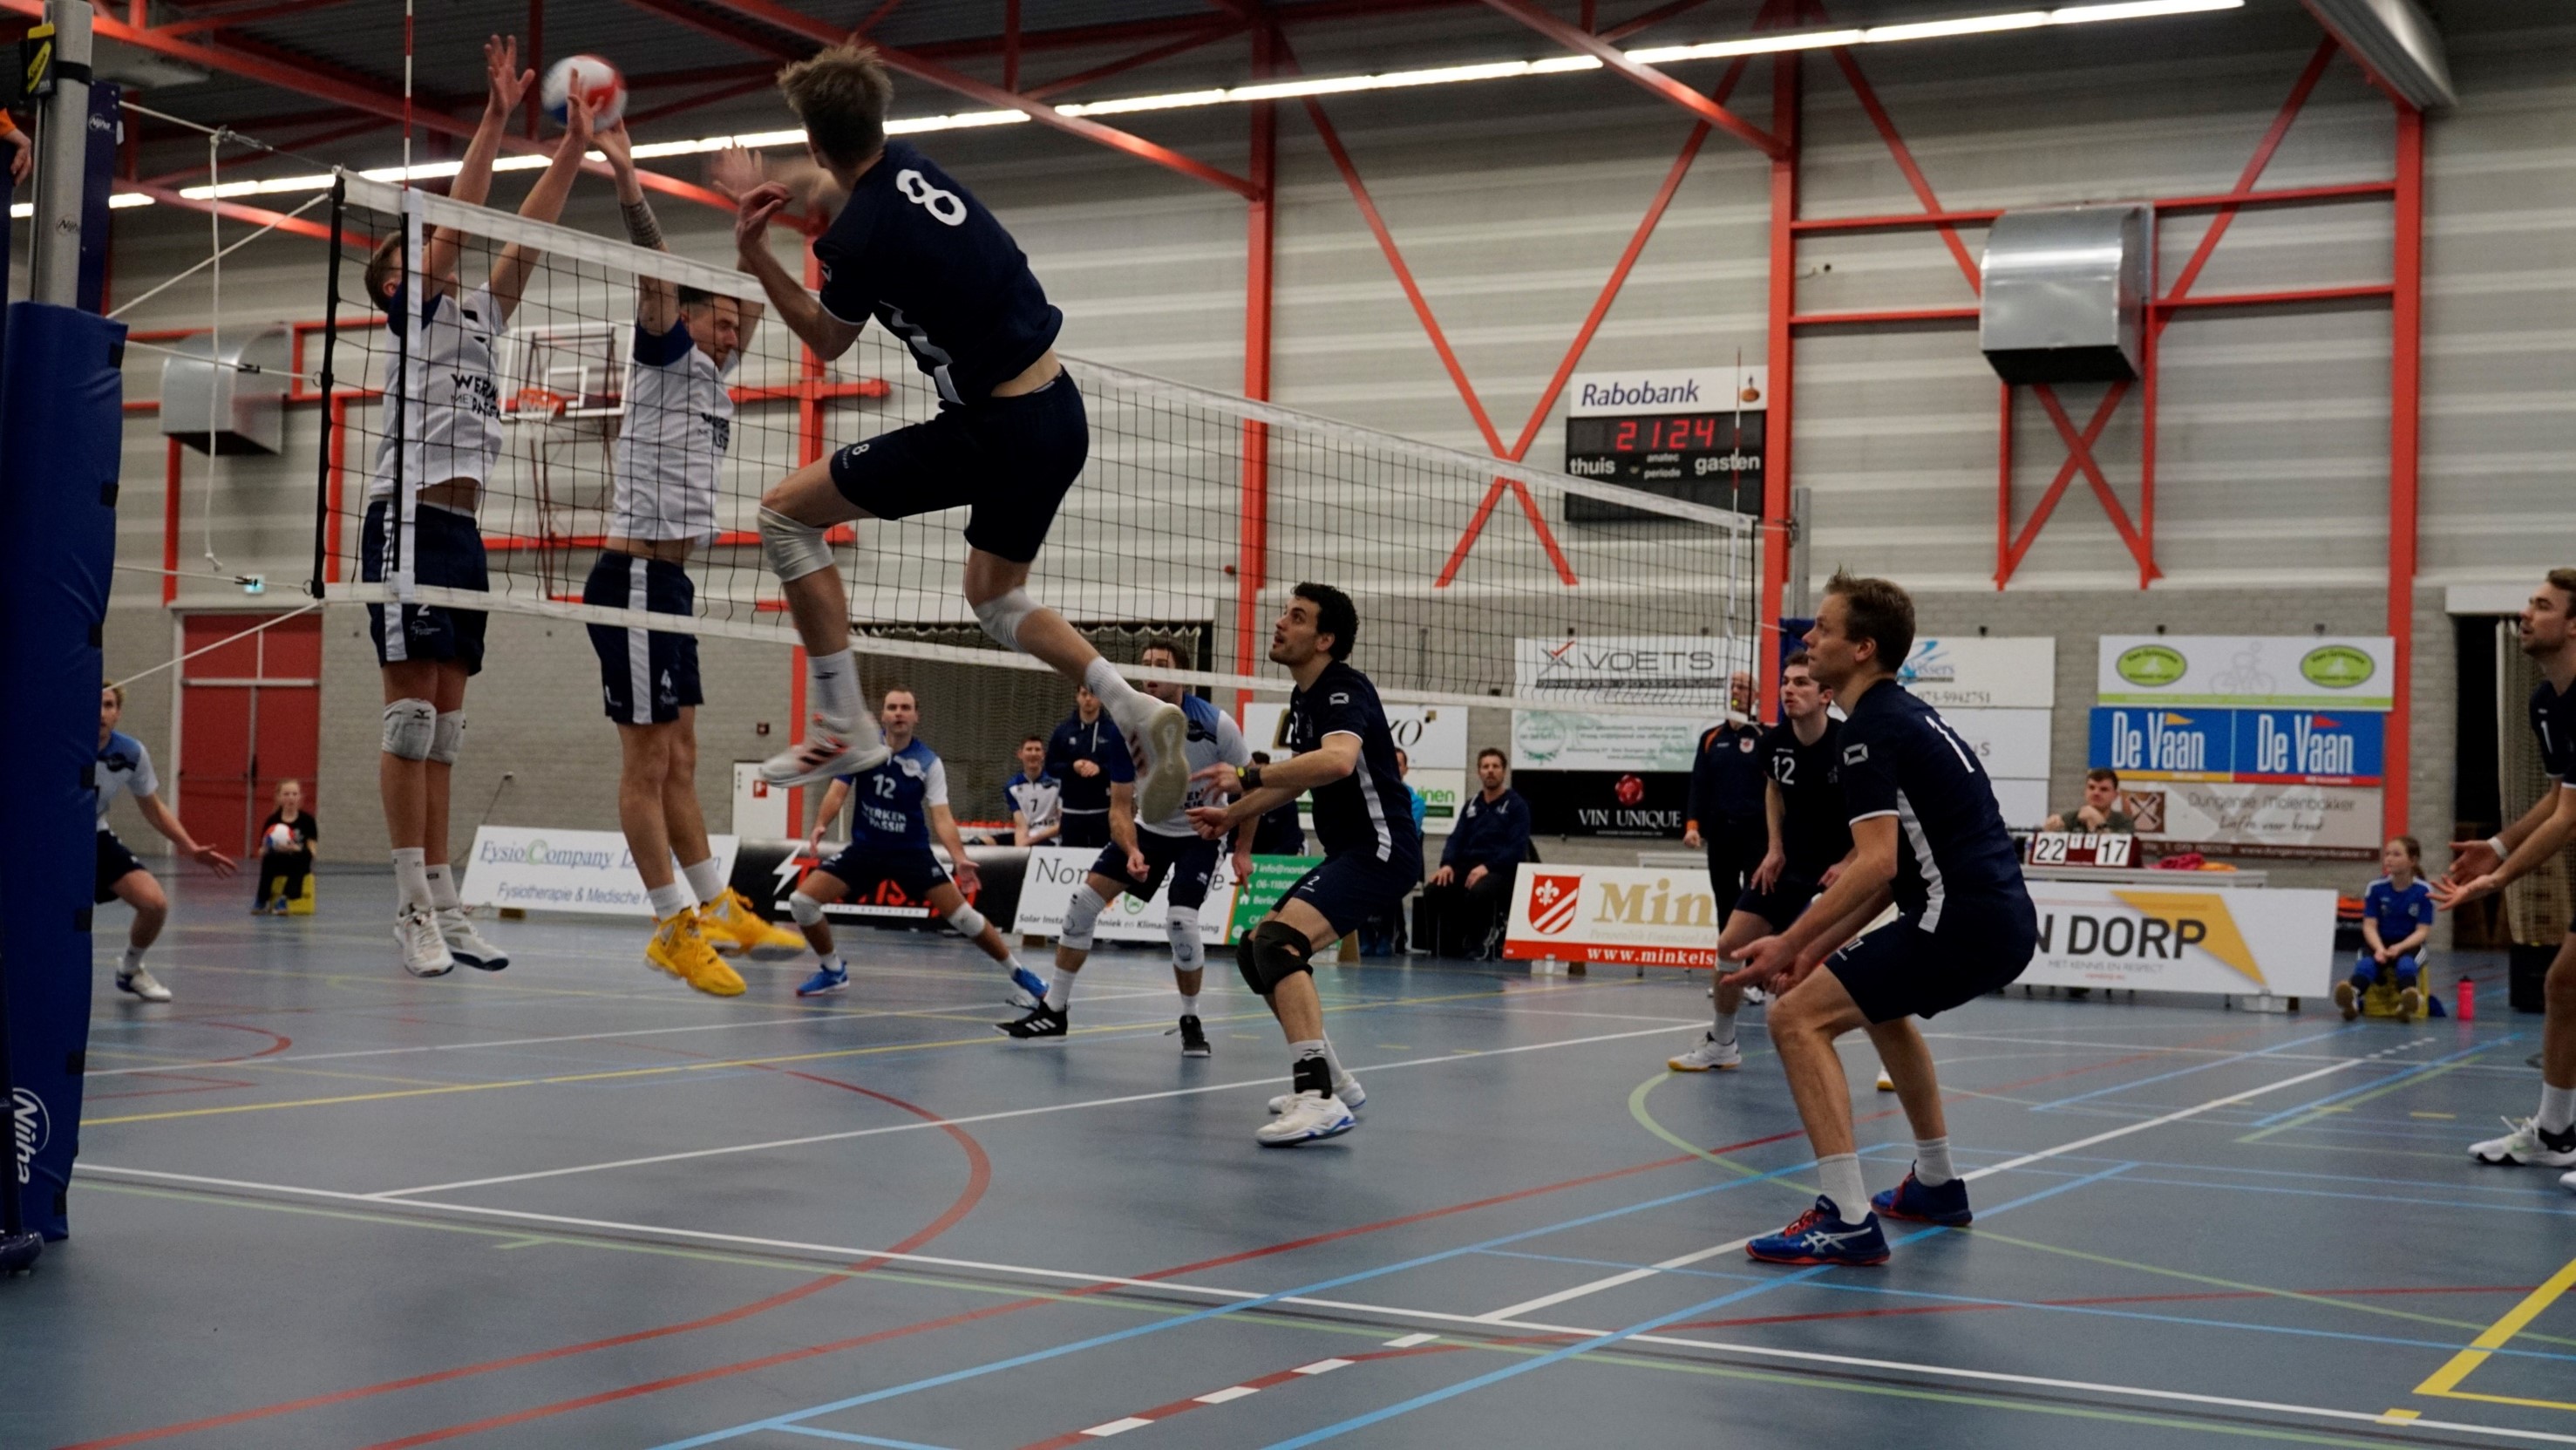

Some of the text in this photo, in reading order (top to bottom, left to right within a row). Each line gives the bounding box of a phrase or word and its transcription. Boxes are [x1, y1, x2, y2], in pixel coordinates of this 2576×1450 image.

[896, 169, 968, 227] 8
[1580, 378, 1700, 407] Rabobank
[852, 443, 870, 457] 8
[1569, 454, 1761, 476] thuis gasten
[1583, 651, 1715, 671] VOETS
[2111, 711, 2206, 771] De Vaan
[2256, 713, 2355, 775] De Vaan
[1772, 755, 1796, 785] 12
[873, 774, 896, 800] 12
[1030, 799, 1038, 813] 7
[1578, 808, 1682, 829] VIN UNIQUE
[479, 839, 614, 870] FysioCompany
[2036, 838, 2065, 861] 22
[2102, 840, 2127, 863] 17
[498, 882, 573, 903] Fysiotherapie
[574, 887, 585, 902] &
[587, 887, 641, 904] Medische
[1308, 875, 1320, 886] 2
[1592, 877, 1716, 928] Min
[1018, 915, 1040, 924] Solar
[2067, 914, 2207, 960] DORP
